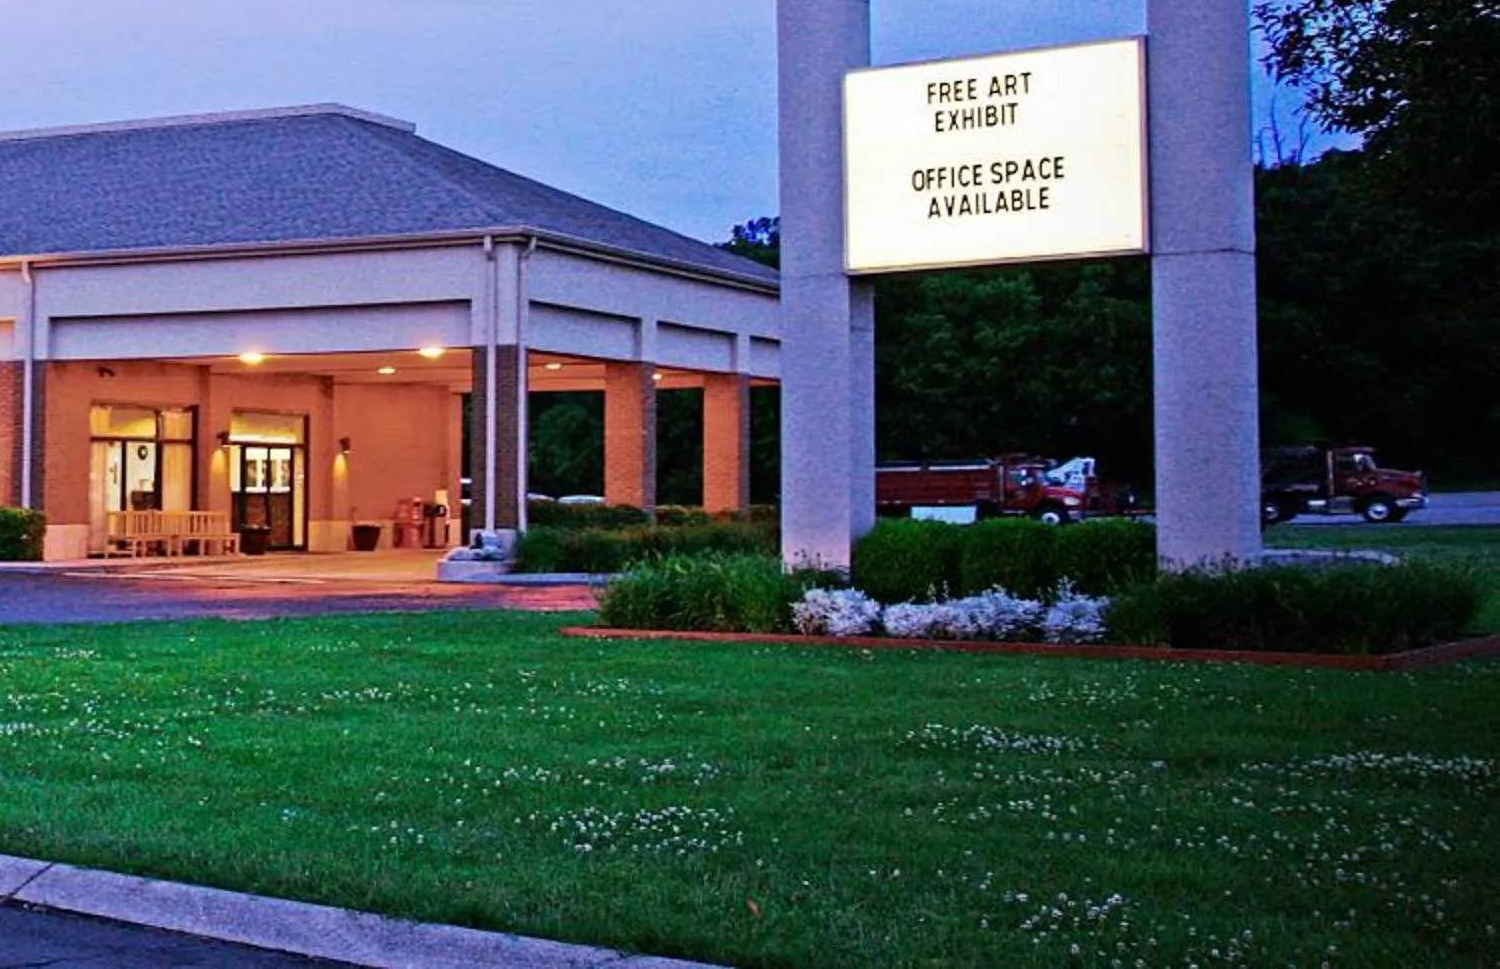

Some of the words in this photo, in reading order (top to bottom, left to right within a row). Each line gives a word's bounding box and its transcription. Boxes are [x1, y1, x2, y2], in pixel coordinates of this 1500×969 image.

[927, 78, 977, 105] FREE
[988, 72, 1033, 97] ART
[935, 103, 1019, 132] EXHIBIT
[912, 164, 983, 192] OFFICE
[991, 156, 1065, 184] SPACE
[928, 187, 1050, 219] AVAILABLE
